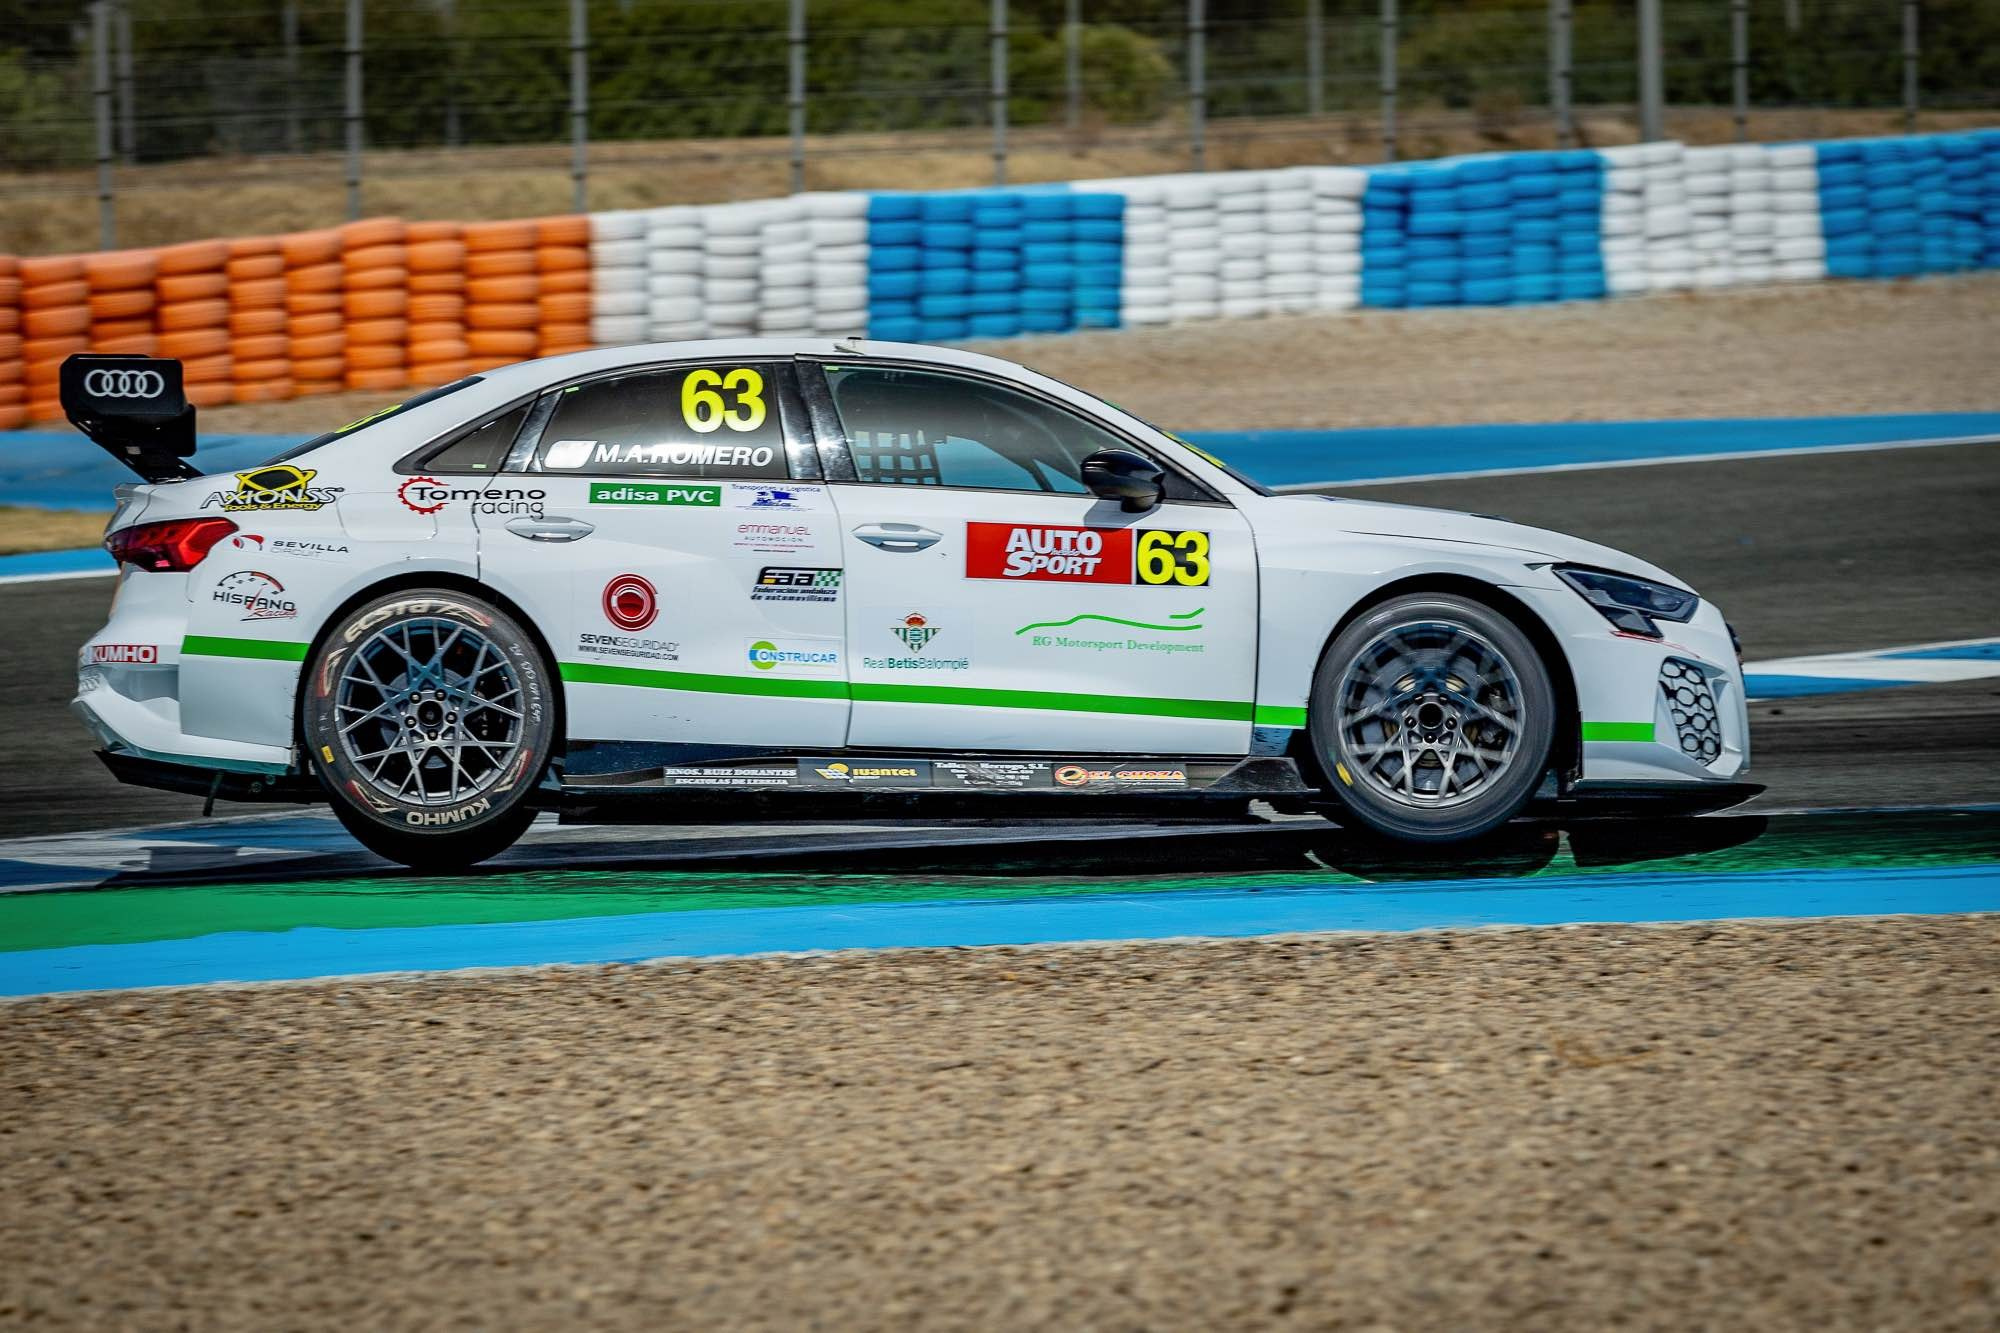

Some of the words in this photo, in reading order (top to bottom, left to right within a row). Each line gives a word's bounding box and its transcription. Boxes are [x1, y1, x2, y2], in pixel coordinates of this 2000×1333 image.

[682, 368, 766, 433] 63
[412, 486, 547, 501] Tomeno
[596, 488, 659, 502] adisa
[666, 489, 715, 504] PVC
[472, 499, 544, 519] racing
[273, 540, 350, 554] SEVILLA
[1005, 528, 1103, 556] AUTO
[1137, 530, 1211, 587] 63
[213, 591, 296, 612] HISPANO
[93, 646, 155, 663] KUMHO
[1055, 637, 1123, 651] Motorsport
[1127, 640, 1205, 654] Development
[406, 797, 491, 826] KUMHO
